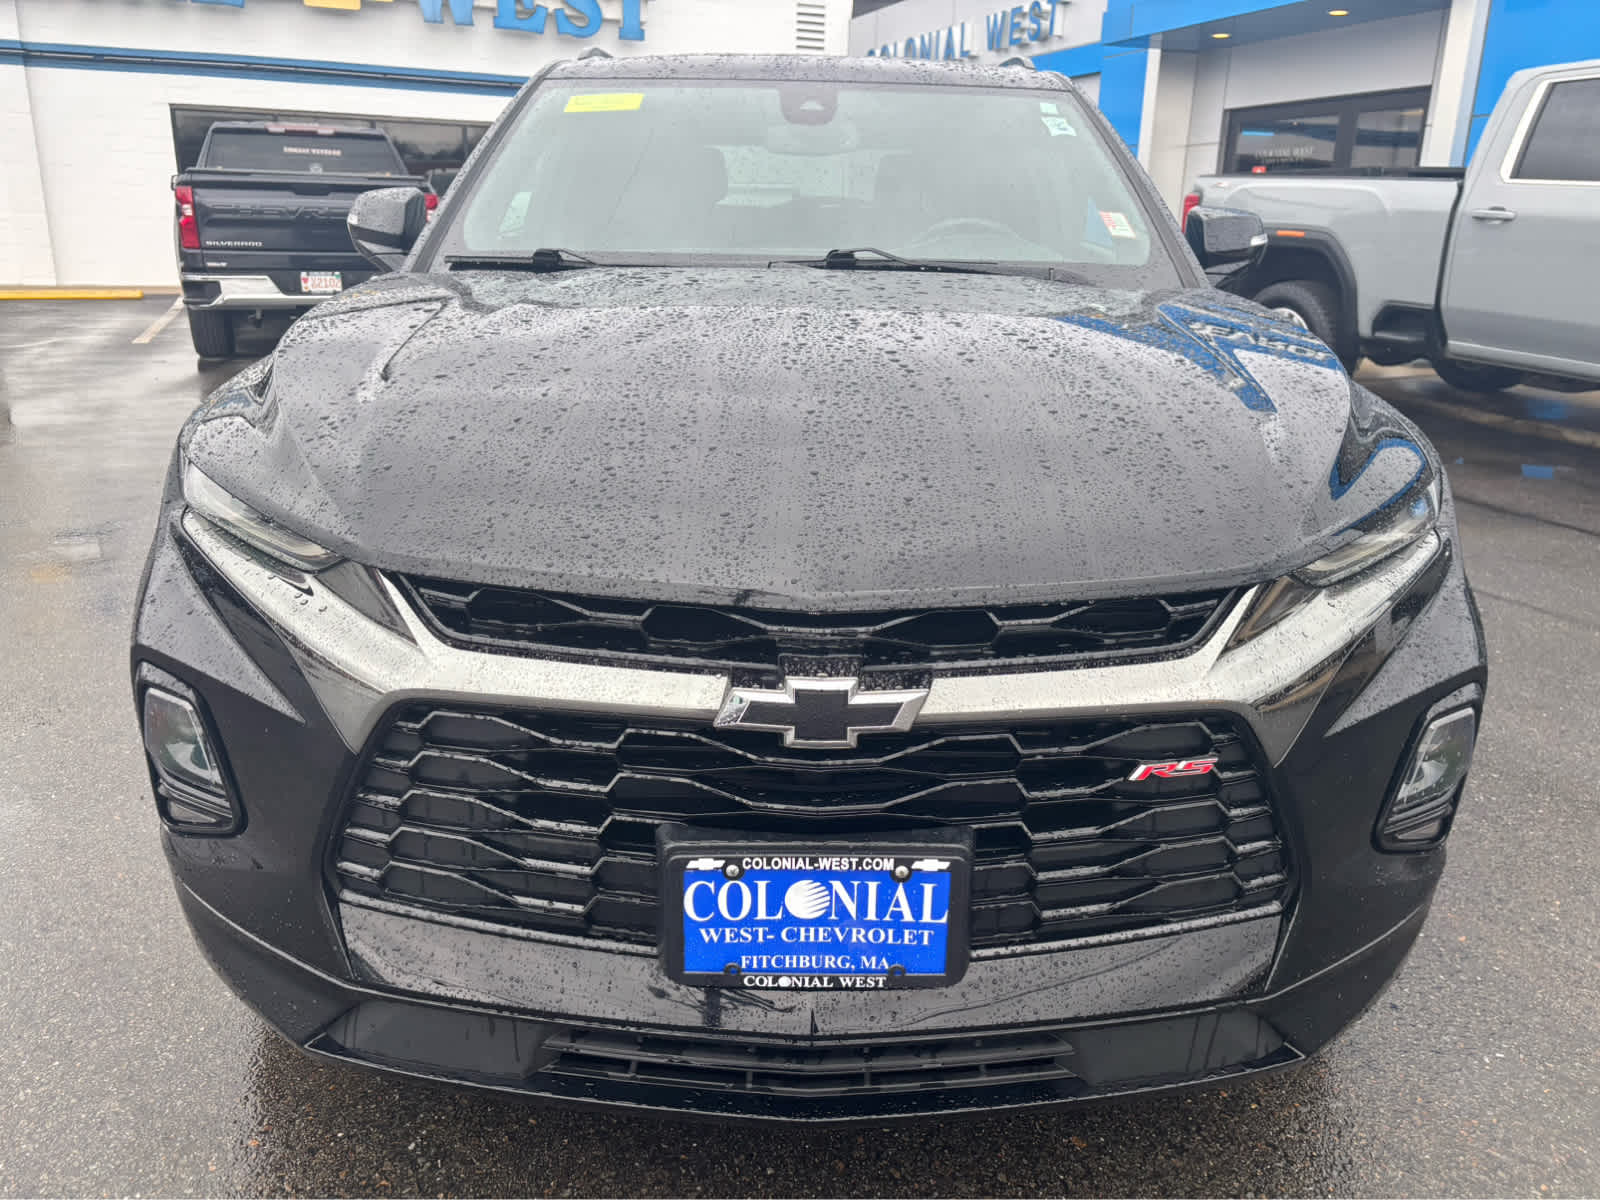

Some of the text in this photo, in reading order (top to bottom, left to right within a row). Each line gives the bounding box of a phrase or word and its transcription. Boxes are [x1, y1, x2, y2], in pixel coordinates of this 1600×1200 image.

[986, 0, 1063, 51] WEST
[1128, 758, 1218, 781] RS
[742, 857, 894, 871] COLONIAL-WEST.COM
[683, 879, 948, 923] COLONIAL
[781, 926, 934, 945] CHEVROLET
[741, 954, 889, 970] FITCHBURG, MA
[743, 975, 887, 988] COLONIAL WEST
